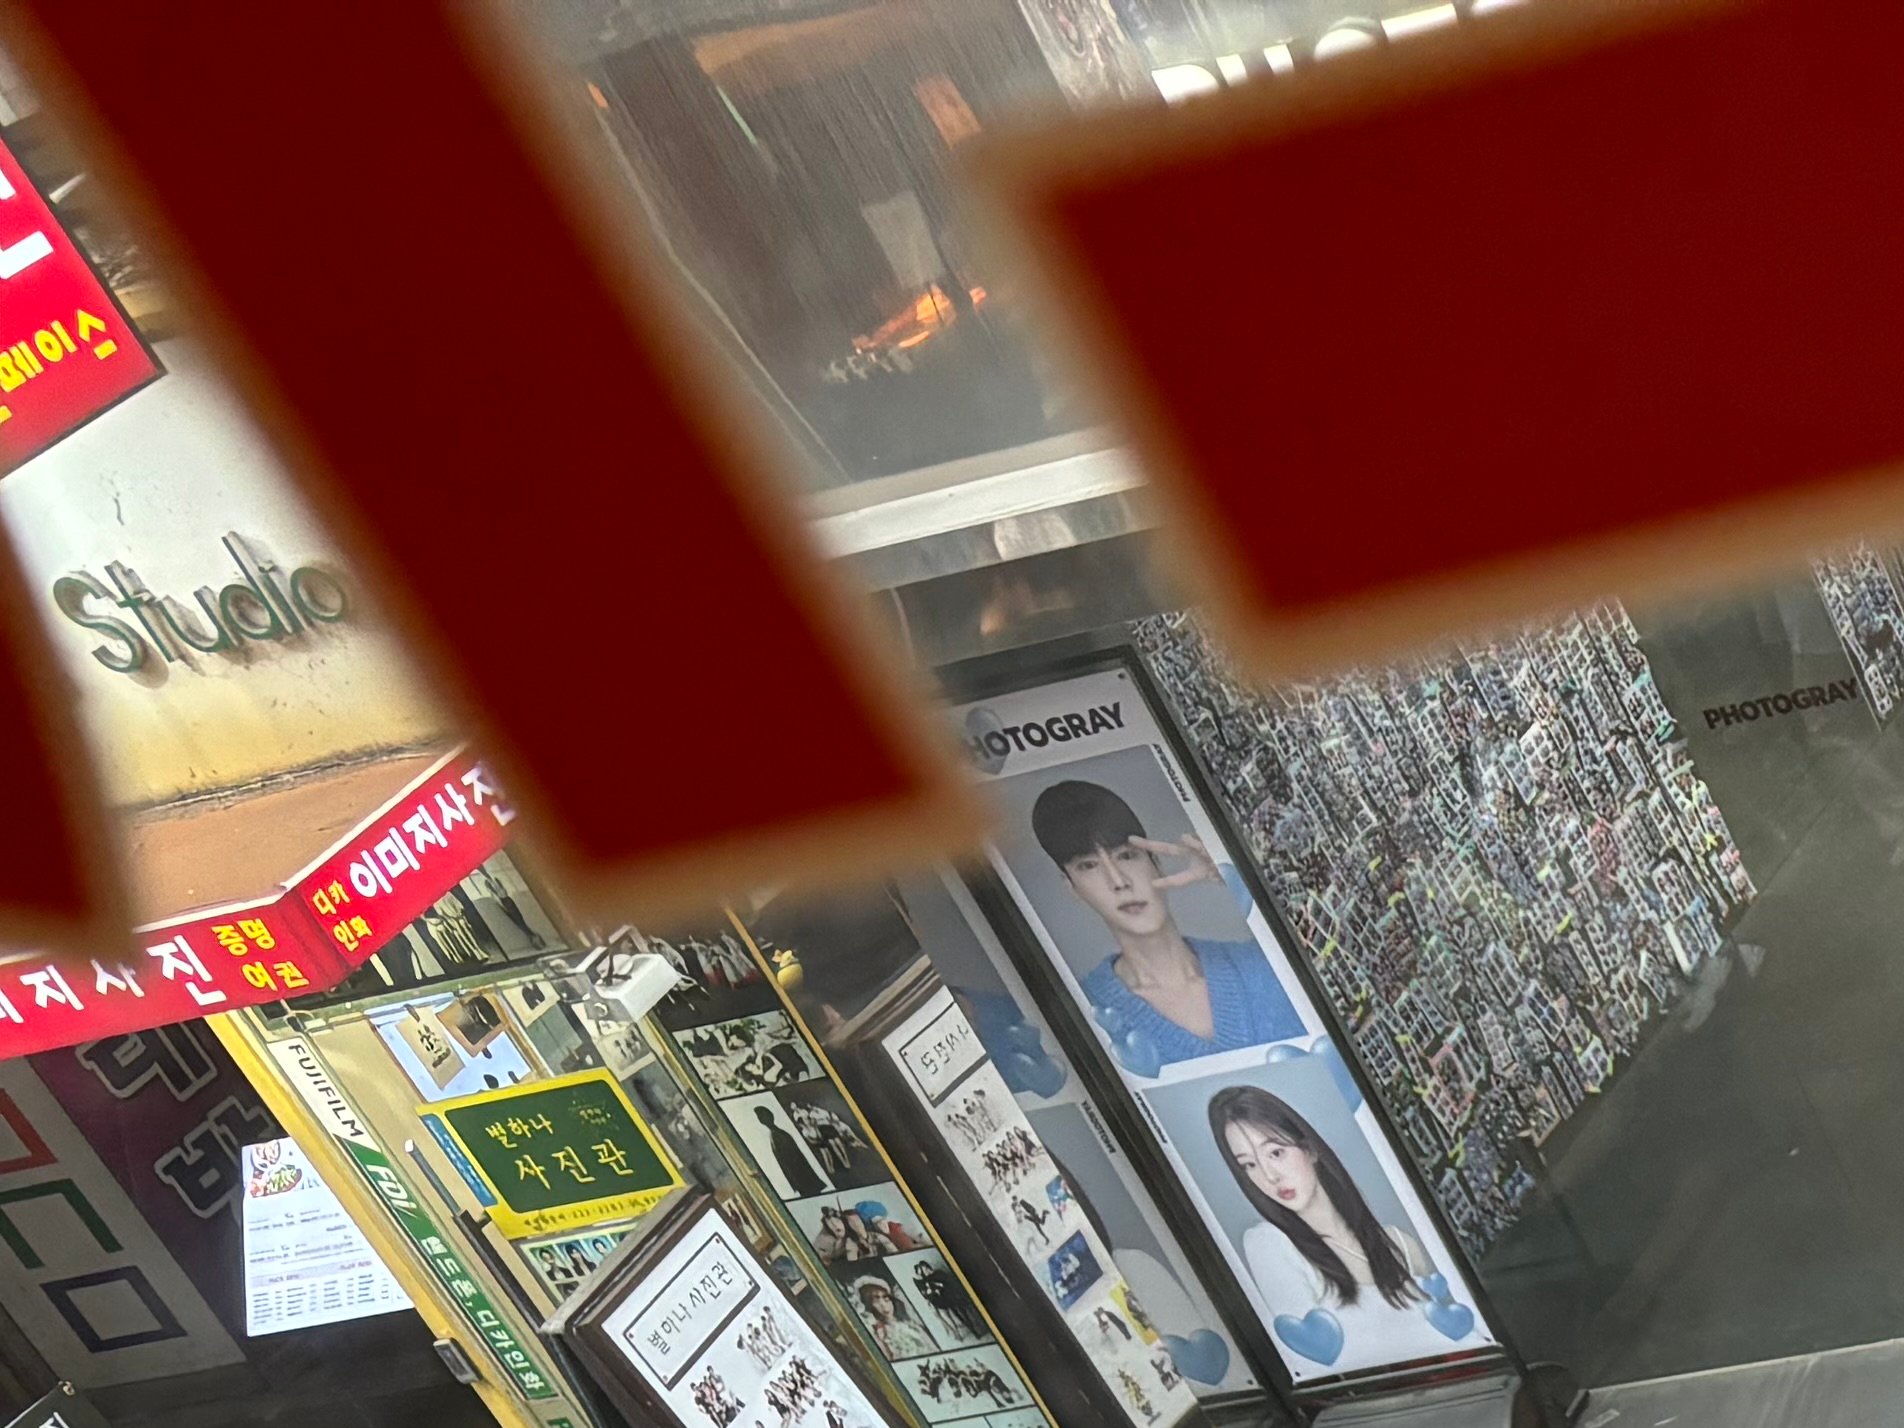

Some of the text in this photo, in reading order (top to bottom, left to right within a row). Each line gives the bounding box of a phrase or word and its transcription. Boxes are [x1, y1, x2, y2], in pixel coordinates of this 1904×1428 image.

[52, 530, 349, 674] Studio
[1703, 677, 1858, 730] PHOTOGRAY
[970, 702, 1126, 764] HOTOGRAY
[312, 879, 352, 916] 디카
[212, 918, 277, 960] 증명
[333, 916, 373, 953] 인화
[241, 960, 310, 993] 여권
[288, 1043, 365, 1138] FUJIFILM
[485, 1113, 555, 1149] 별하나
[514, 1138, 635, 1190] 사진관
